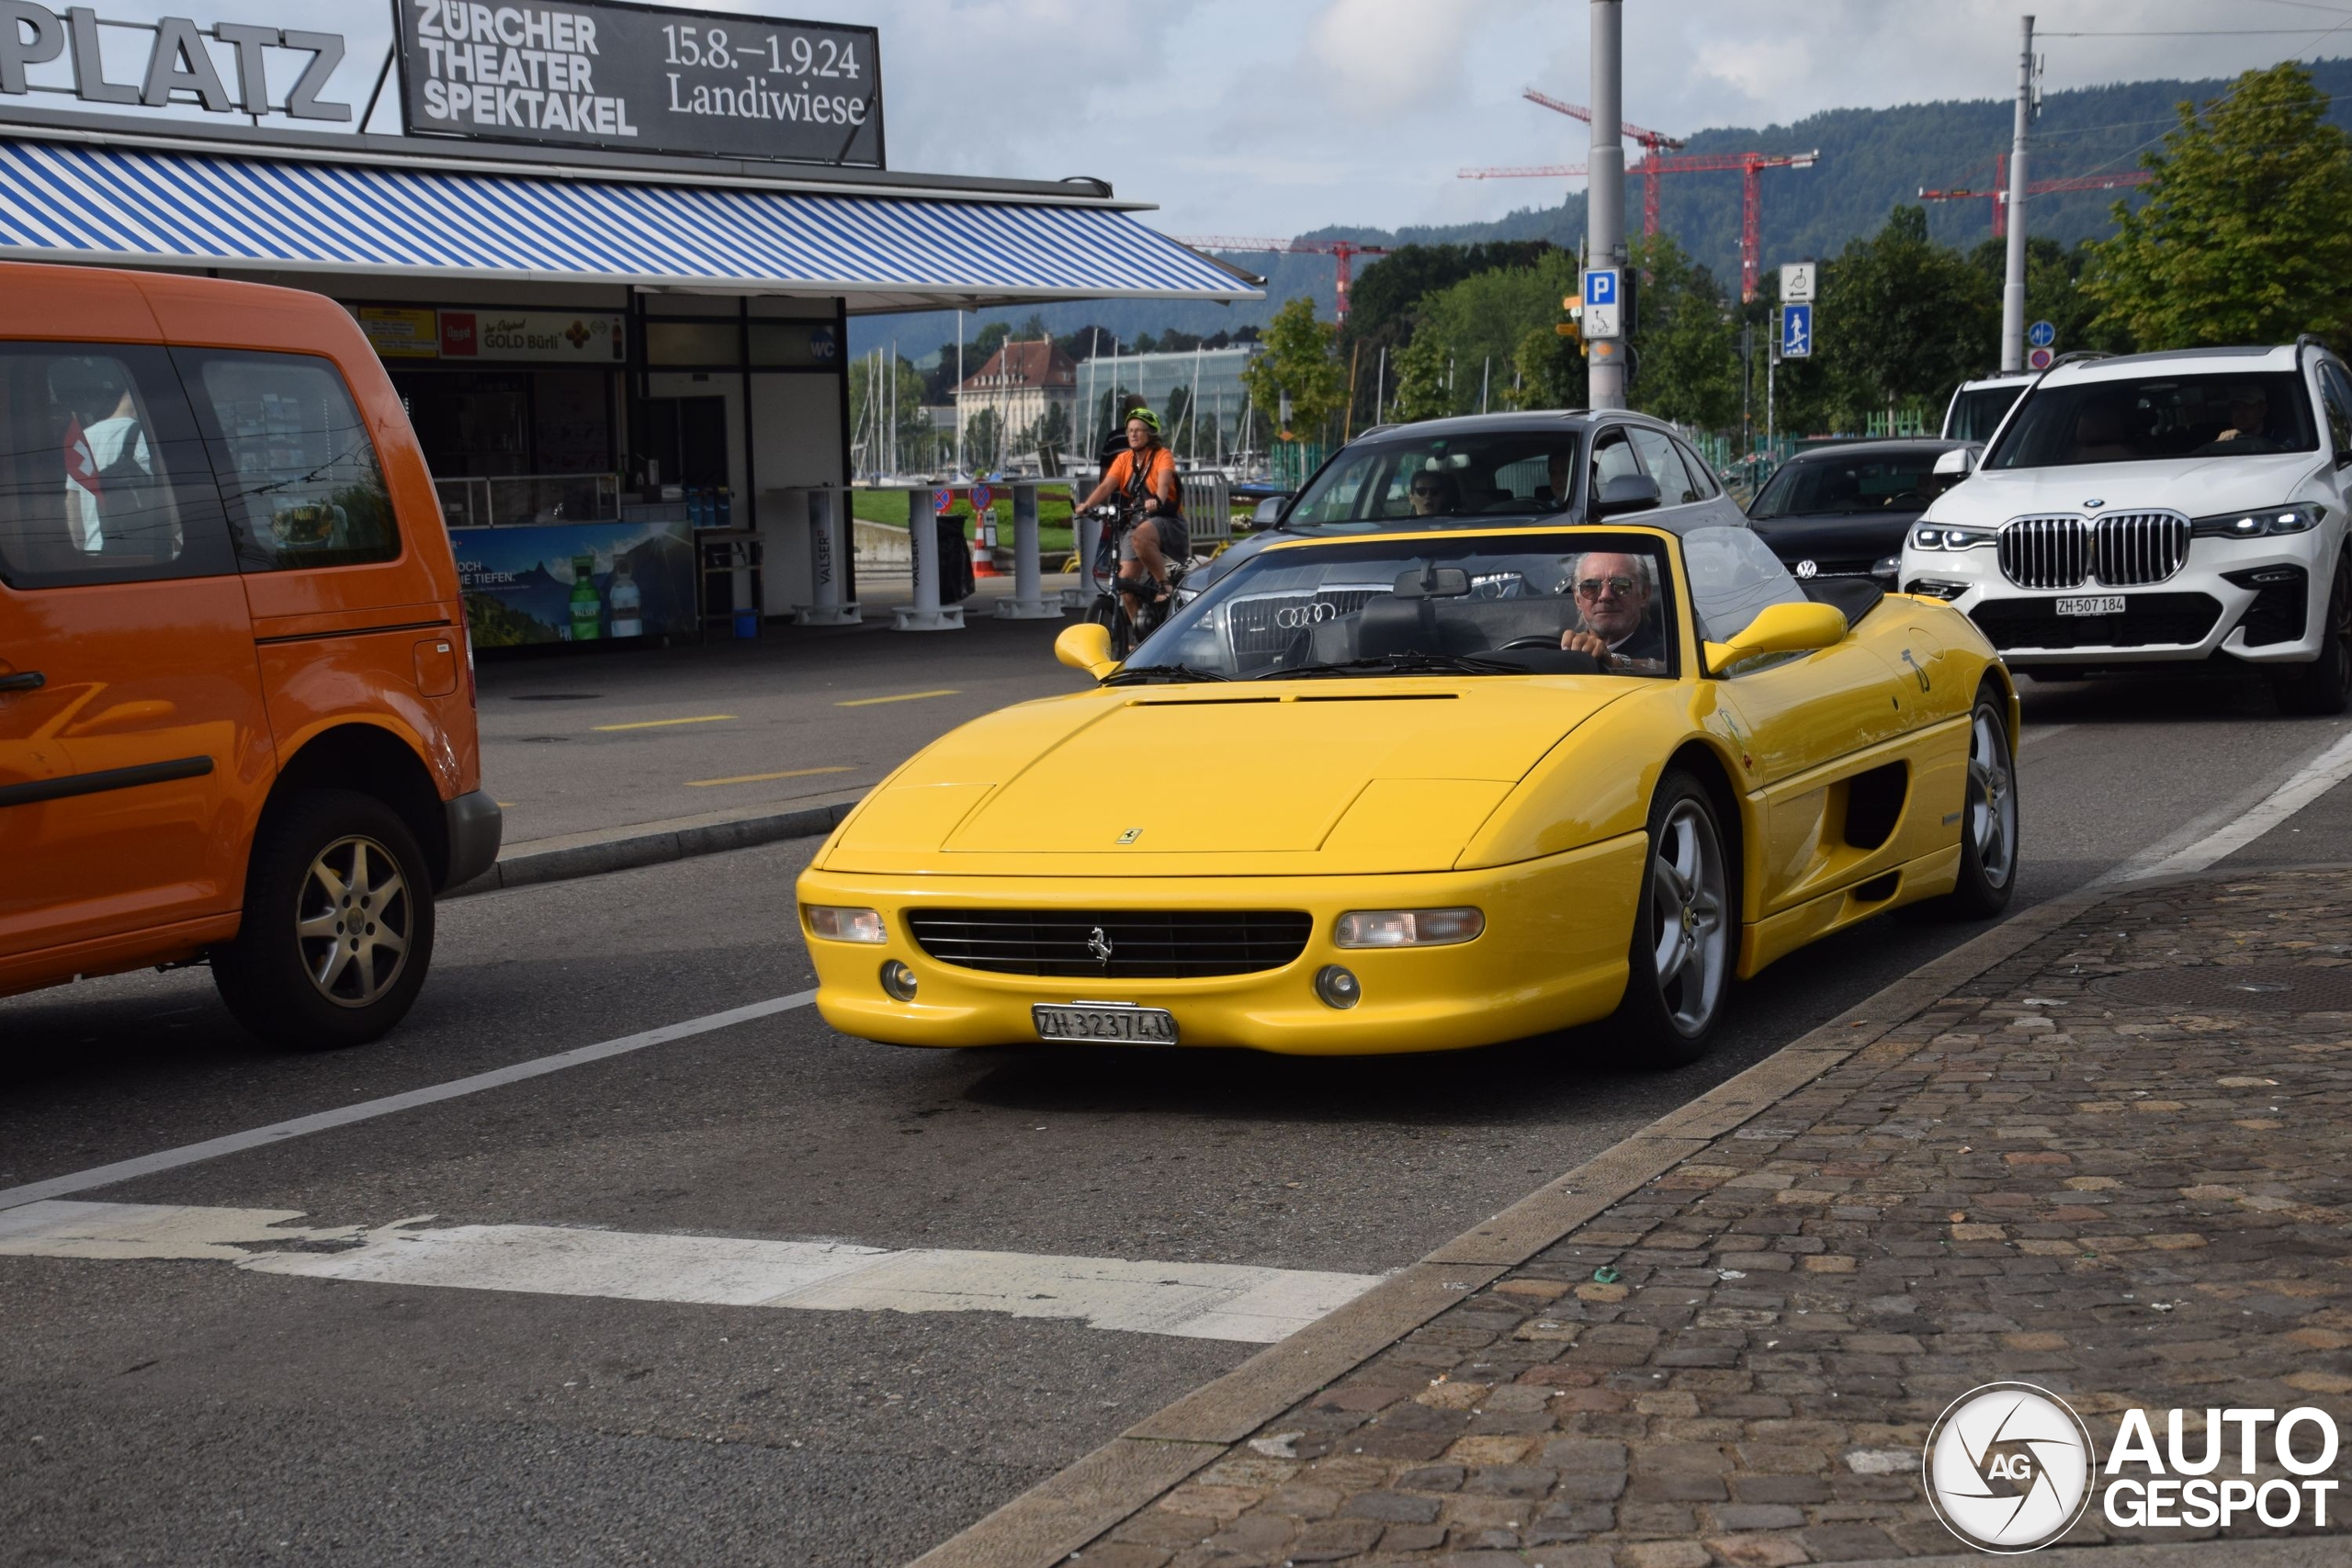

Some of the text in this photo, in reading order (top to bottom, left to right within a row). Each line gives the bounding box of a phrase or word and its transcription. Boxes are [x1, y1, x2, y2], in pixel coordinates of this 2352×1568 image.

[415, 0, 600, 56] ZÜRCHER
[0, 0, 352, 122] PLATZ
[419, 37, 595, 95] THEATER
[424, 79, 639, 137] SPEKTAKEL
[666, 73, 866, 126] Landiwiese
[1594, 276, 1610, 302] P
[484, 334, 525, 349] GOLD
[810, 341, 835, 358] WC
[474, 572, 516, 584] TIEFEN.
[818, 536, 831, 585] VALSER
[2102, 597, 2123, 612] 184
